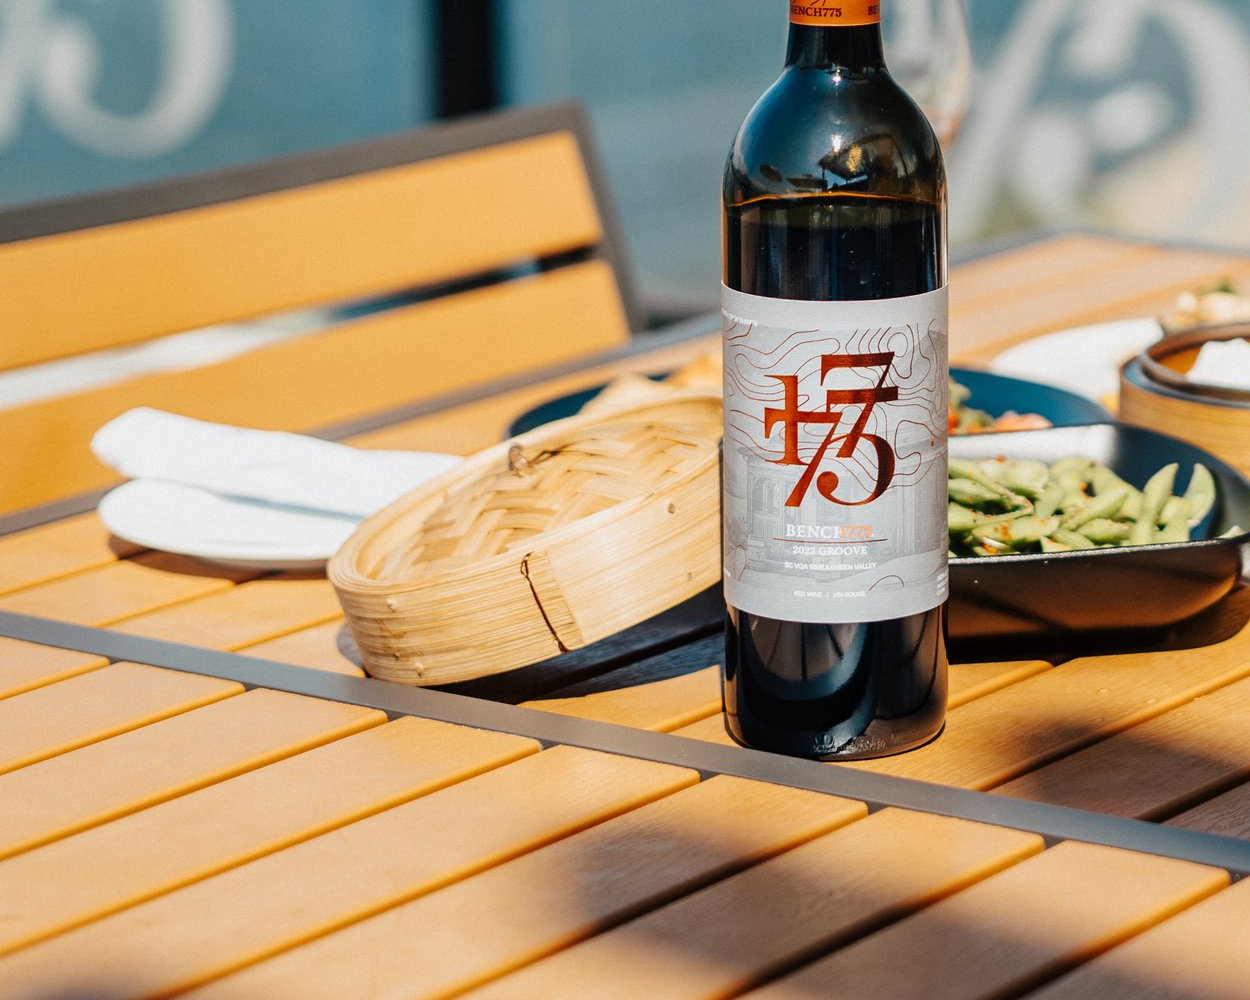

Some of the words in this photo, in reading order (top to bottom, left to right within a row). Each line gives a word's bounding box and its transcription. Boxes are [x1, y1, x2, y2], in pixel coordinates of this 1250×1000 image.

[792, 545, 816, 555] 2022
[818, 545, 868, 556] GROOVE
[854, 562, 877, 570] VALLEY
